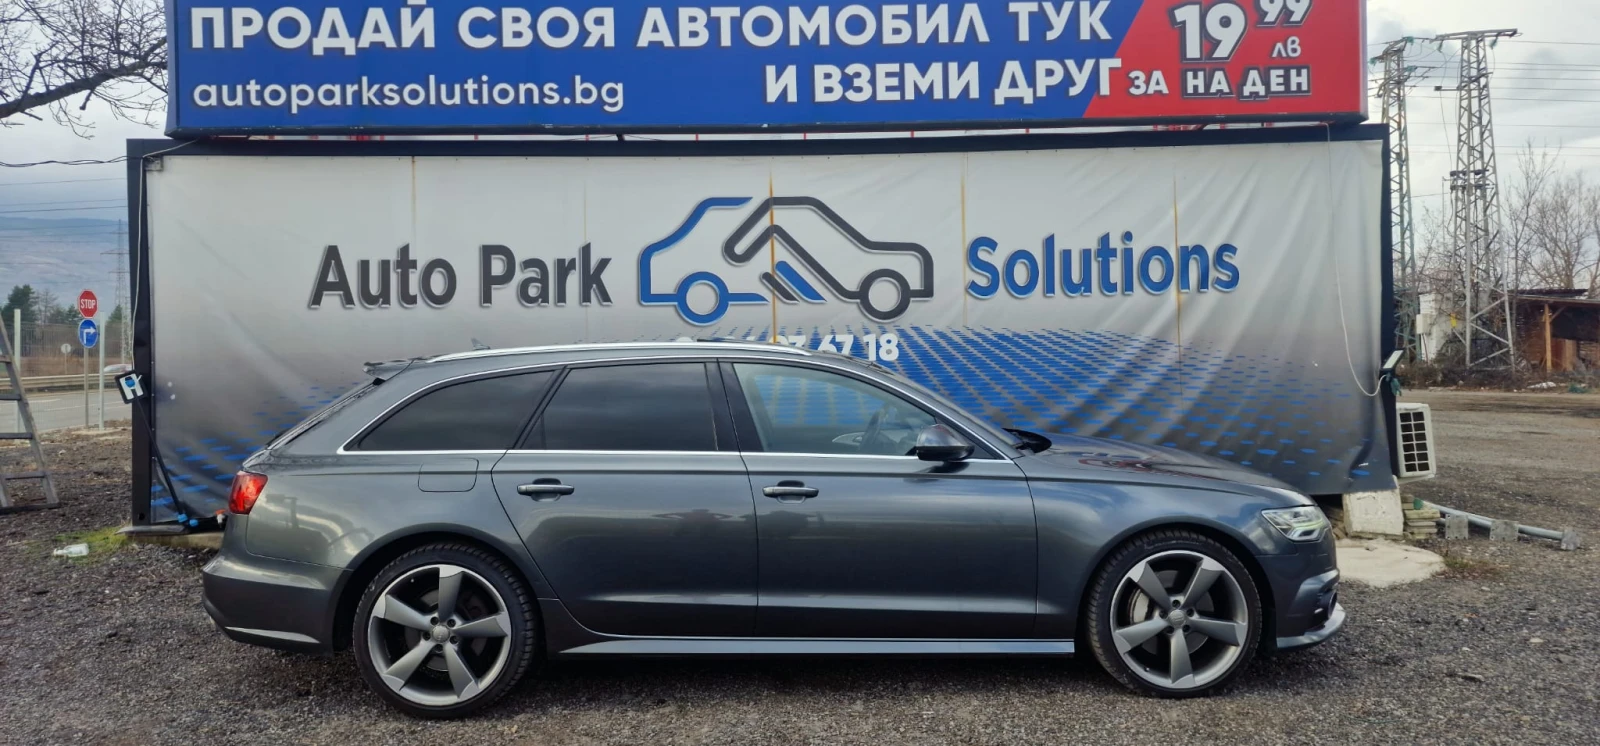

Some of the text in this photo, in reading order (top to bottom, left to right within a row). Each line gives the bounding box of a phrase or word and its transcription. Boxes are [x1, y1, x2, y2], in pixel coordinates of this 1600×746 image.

[190, 0, 1113, 56] ПРОДАЙ СВОЯ АВТОМОБИЛ ТУК
[1172, 0, 1312, 60] 19 99
[1271, 36, 1302, 58] лв
[193, 75, 625, 114] autoparksolutions.bg
[765, 58, 1309, 106] И ВЗЕМИ ДРУГ ЗА НА ДЕН
[307, 230, 1241, 308] Auto Park Solutions
[80, 299, 96, 309] STOP
[862, 333, 900, 362] 18
